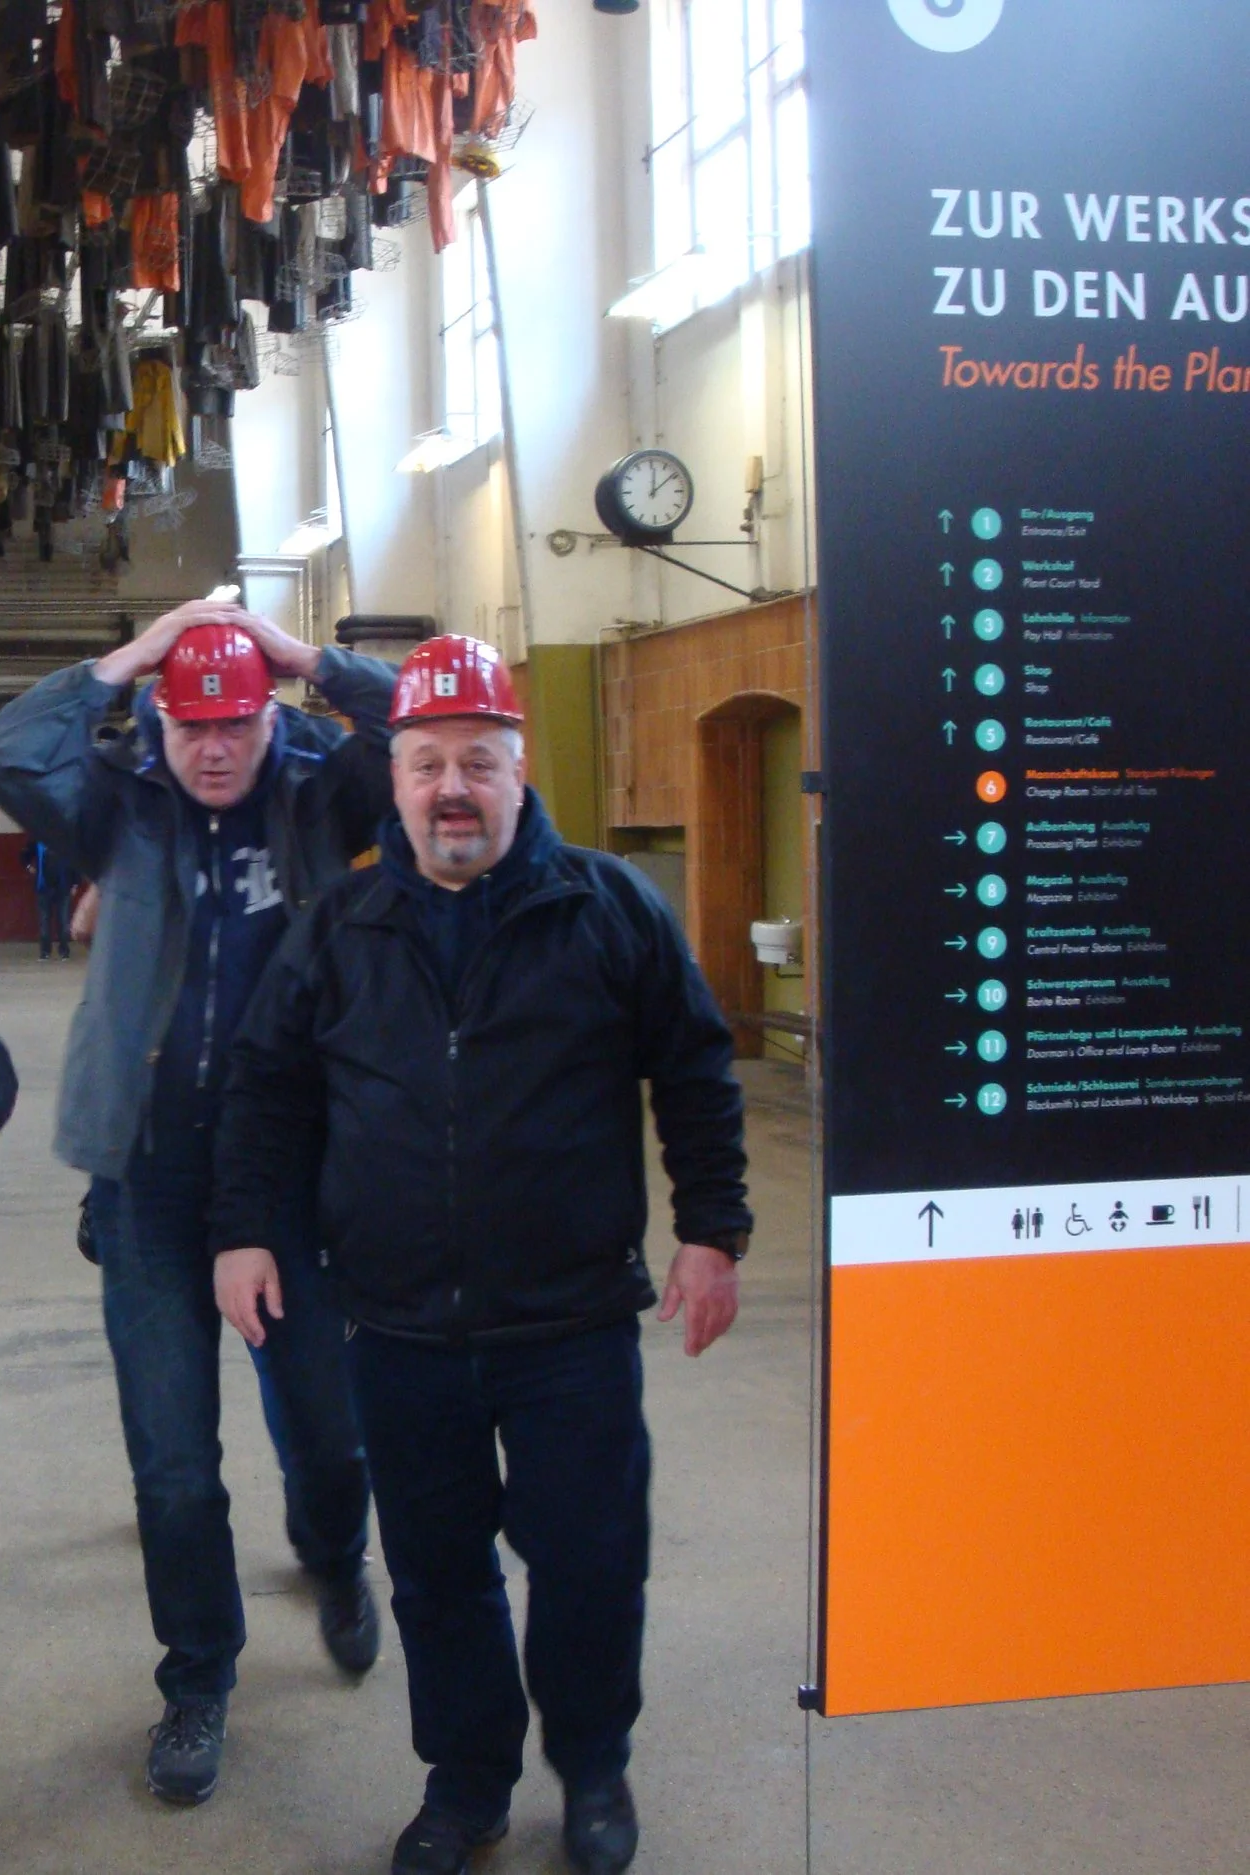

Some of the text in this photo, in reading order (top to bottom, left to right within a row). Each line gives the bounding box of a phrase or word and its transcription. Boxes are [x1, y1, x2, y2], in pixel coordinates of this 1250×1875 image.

[930, 189, 1041, 239] ZUR
[933, 267, 1248, 322] ZU DEN AU
[939, 344, 1098, 389] Towards
[1113, 344, 1171, 391] the
[984, 516, 990, 530] 1
[983, 567, 993, 582] 2
[985, 618, 994, 633] 3
[1023, 665, 1052, 677] Shop
[985, 673, 994, 687] 4
[1025, 682, 1049, 694] Shop
[986, 728, 996, 743] 5
[985, 781, 996, 795] 6
[1063, 786, 1089, 796] Room
[988, 831, 996, 844] 7
[988, 883, 997, 898] 8
[987, 936, 998, 950] 9
[985, 988, 1003, 1003] 10
[985, 1040, 1000, 1053] 11
[984, 1092, 1000, 1106] 12
